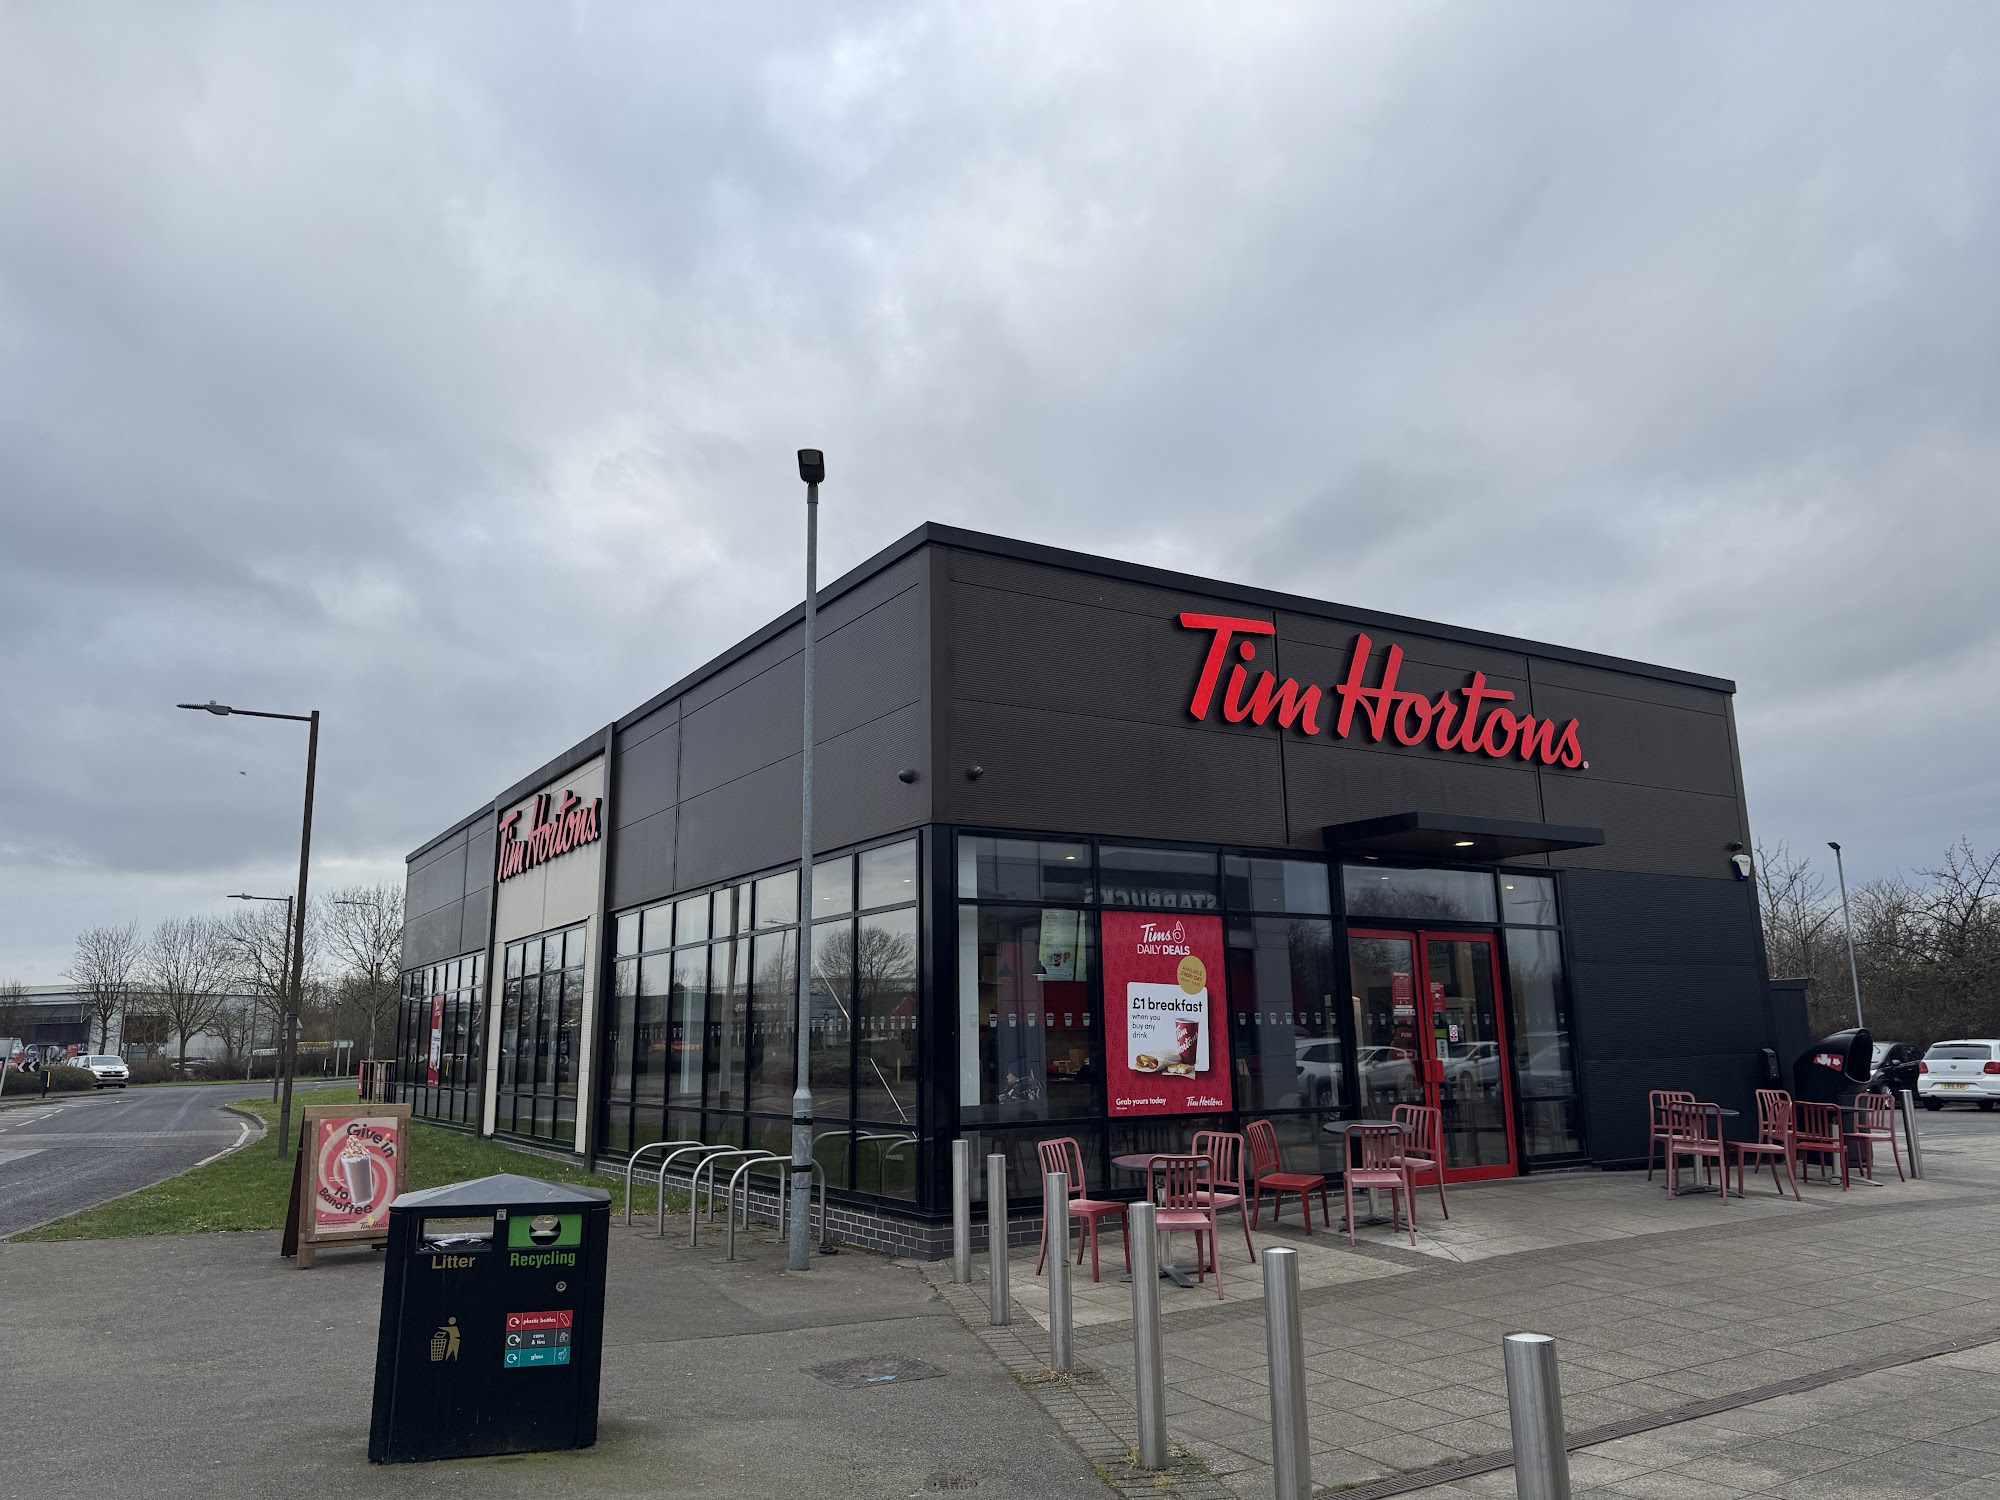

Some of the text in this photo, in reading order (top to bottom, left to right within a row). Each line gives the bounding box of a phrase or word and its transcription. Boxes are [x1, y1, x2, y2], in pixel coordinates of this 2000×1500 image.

[1179, 612, 1583, 769] Tim Hortons
[497, 790, 599, 883] Tim Hortons
[1140, 923, 1172, 943] Tims
[1137, 944, 1191, 956] DAILY DEALS
[1180, 970, 1194, 979] EVERY
[1182, 966, 1203, 976] AVAILABLE
[1132, 997, 1203, 1013] £1 breakfast
[1132, 1013, 1161, 1022] when you
[1132, 1023, 1156, 1032] buy any
[1115, 1096, 1167, 1107] Grab yours today
[1186, 1095, 1223, 1107] Tim Hortons
[346, 1123, 395, 1159] Give in
[334, 1185, 349, 1200] to
[318, 1186, 373, 1215] Banoffee
[359, 1221, 371, 1230] Tim
[371, 1221, 389, 1229] Horto
[431, 1255, 476, 1270] Litter
[509, 1251, 576, 1269] Recycling
[523, 1316, 557, 1326] plastic bottles
[530, 1353, 544, 1361] glass
